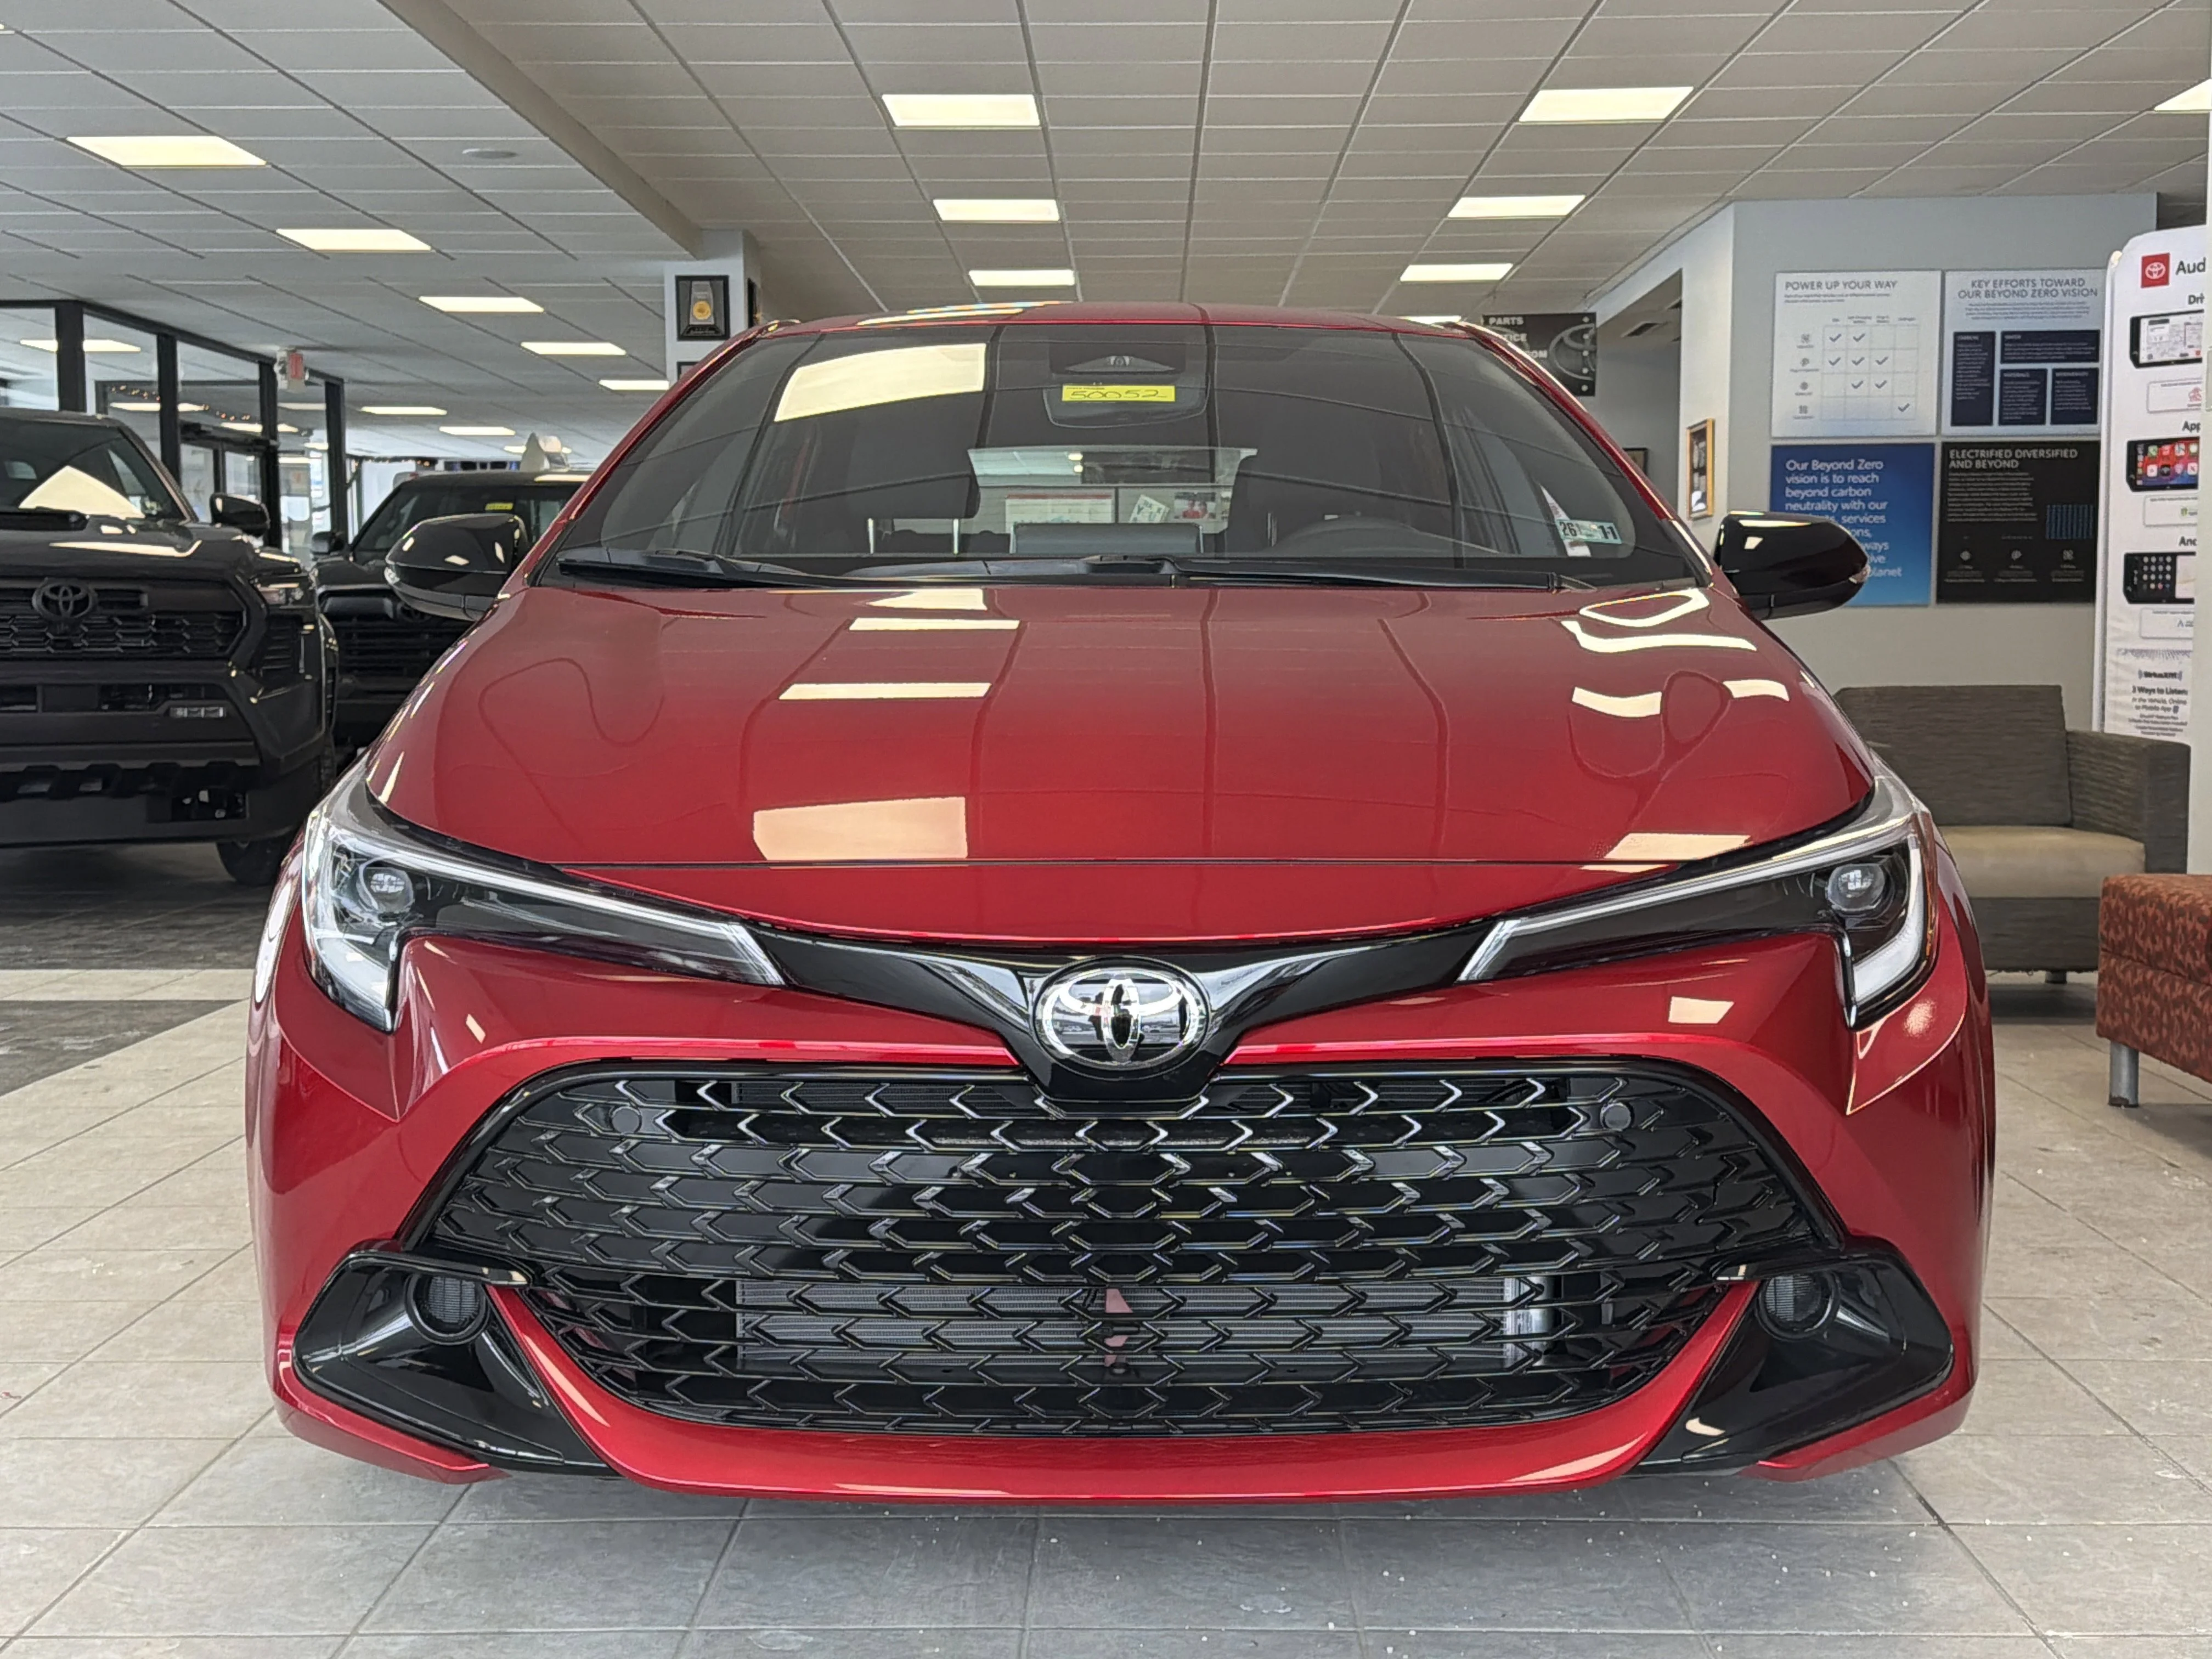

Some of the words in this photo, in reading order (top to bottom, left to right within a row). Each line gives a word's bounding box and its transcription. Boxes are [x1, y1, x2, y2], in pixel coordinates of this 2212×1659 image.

[1785, 280, 1823, 291] POWER
[1825, 280, 1840, 290] UP
[1843, 280, 1871, 290] YOUR
[1875, 279, 1898, 289] WAY
[1971, 279, 1990, 289] KEY
[1993, 278, 2037, 289] EFFORTS
[2040, 277, 2085, 287] TOWARD
[1958, 289, 1982, 299] OUR
[1984, 289, 2028, 299] BEYOND
[2031, 288, 2058, 298] ZERO
[2062, 287, 2098, 297] VISION
[1949, 449, 2013, 459] ELECTRIFIED
[2015, 448, 2078, 459] DIVERSIFIED
[1786, 459, 1809, 471] Our
[1812, 459, 1855, 472] Beyond
[1858, 459, 1884, 470] Zero
[1949, 459, 1973, 469] AND
[1975, 459, 2019, 469] BEYOND
[1785, 473, 1818, 484] vision
[1820, 473, 1830, 484] is
[1832, 474, 1844, 483] to
[1848, 472, 1880, 484] reach
[1785, 486, 1829, 500] beyond
[1831, 486, 1872, 497] carbon
[1785, 500, 1838, 512] neutrality
[1841, 499, 1866, 510] with
[1868, 501, 1888, 510] our
[1841, 514, 1886, 523] services
